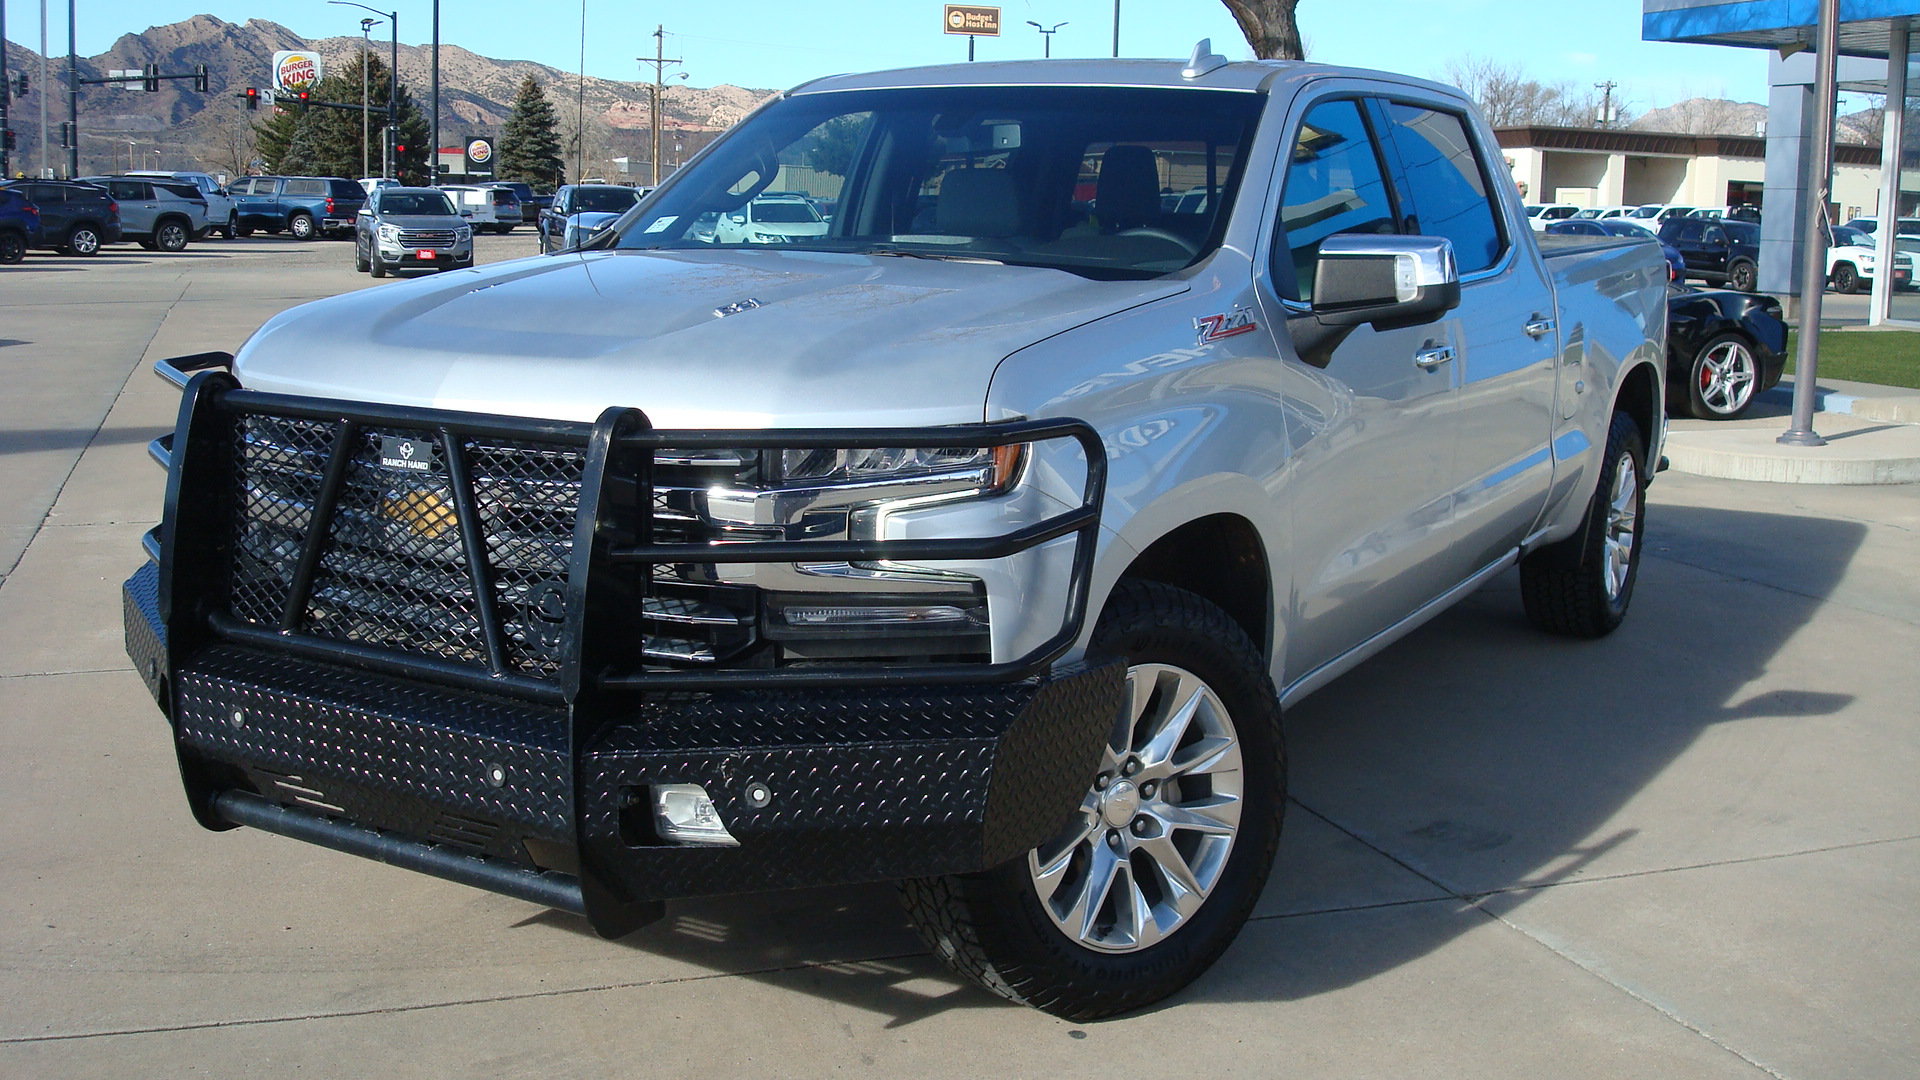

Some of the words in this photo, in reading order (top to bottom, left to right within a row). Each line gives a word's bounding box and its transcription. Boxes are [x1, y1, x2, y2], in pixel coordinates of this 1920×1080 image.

[965, 12, 993, 22] Budget
[965, 20, 984, 28] Host
[984, 21, 997, 29] Inn
[280, 60, 313, 75] BURGER
[282, 69, 315, 87] KING
[382, 457, 407, 468] RANCH
[407, 460, 429, 470] HAND
